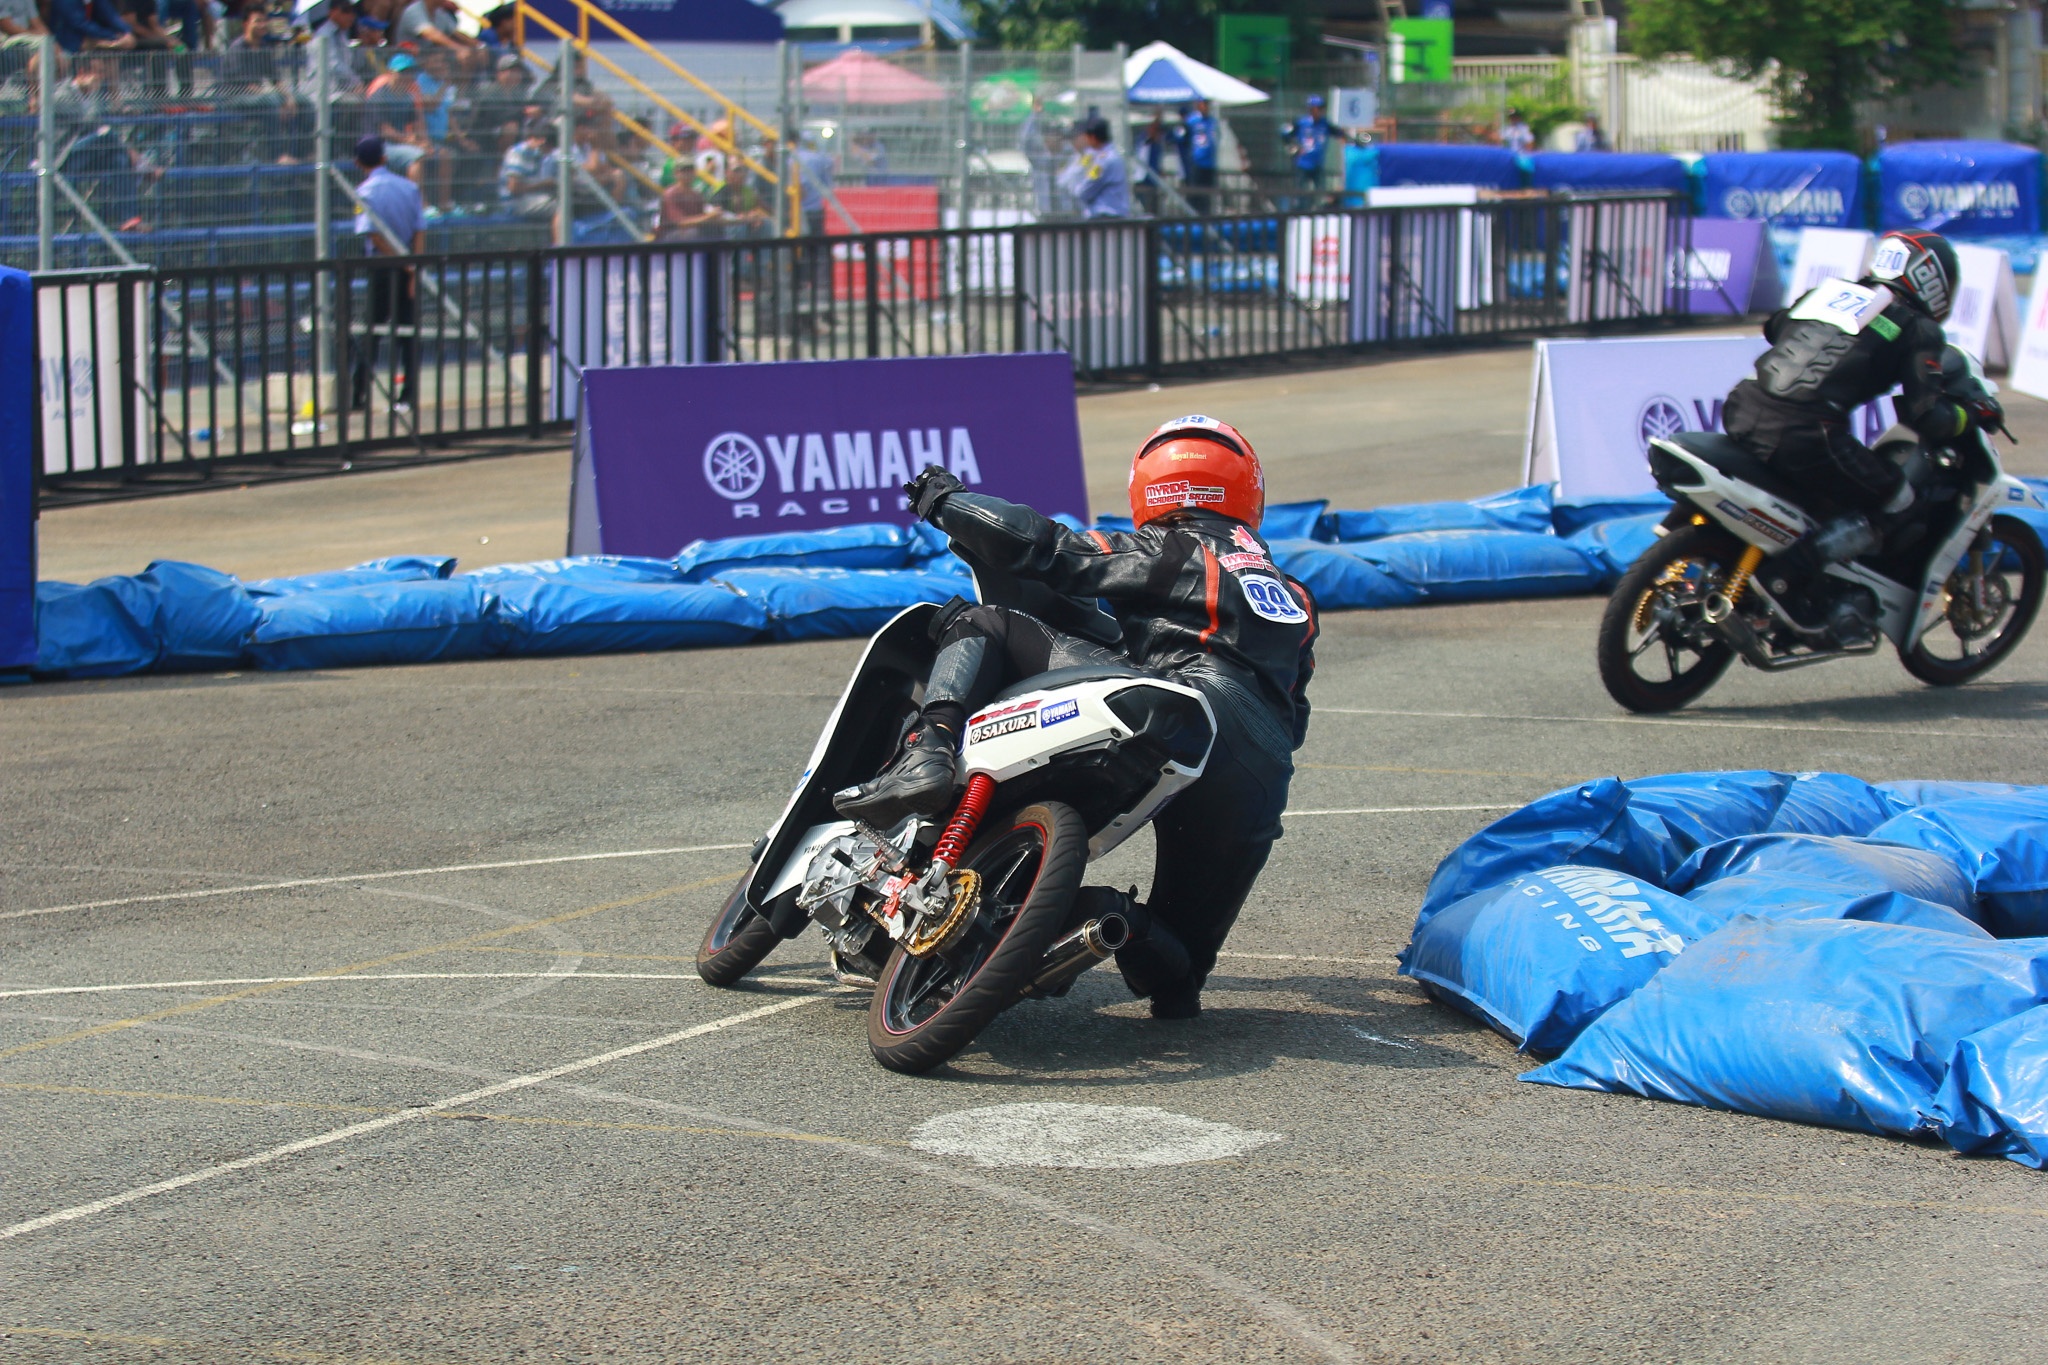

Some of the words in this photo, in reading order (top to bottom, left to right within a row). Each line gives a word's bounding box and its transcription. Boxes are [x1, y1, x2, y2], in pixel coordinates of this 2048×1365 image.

[765, 427, 982, 494] YAMAHA
[1171, 452, 1189, 462] Royal
[1146, 481, 1189, 497] MYRIDE
[733, 498, 910, 519] RACI
[1245, 581, 1300, 616] 99
[1049, 700, 1077, 717] YAMAHA
[981, 712, 1036, 740] SAKURA
[1505, 878, 1602, 952] ACING
[1536, 865, 1686, 959] AMAHA
